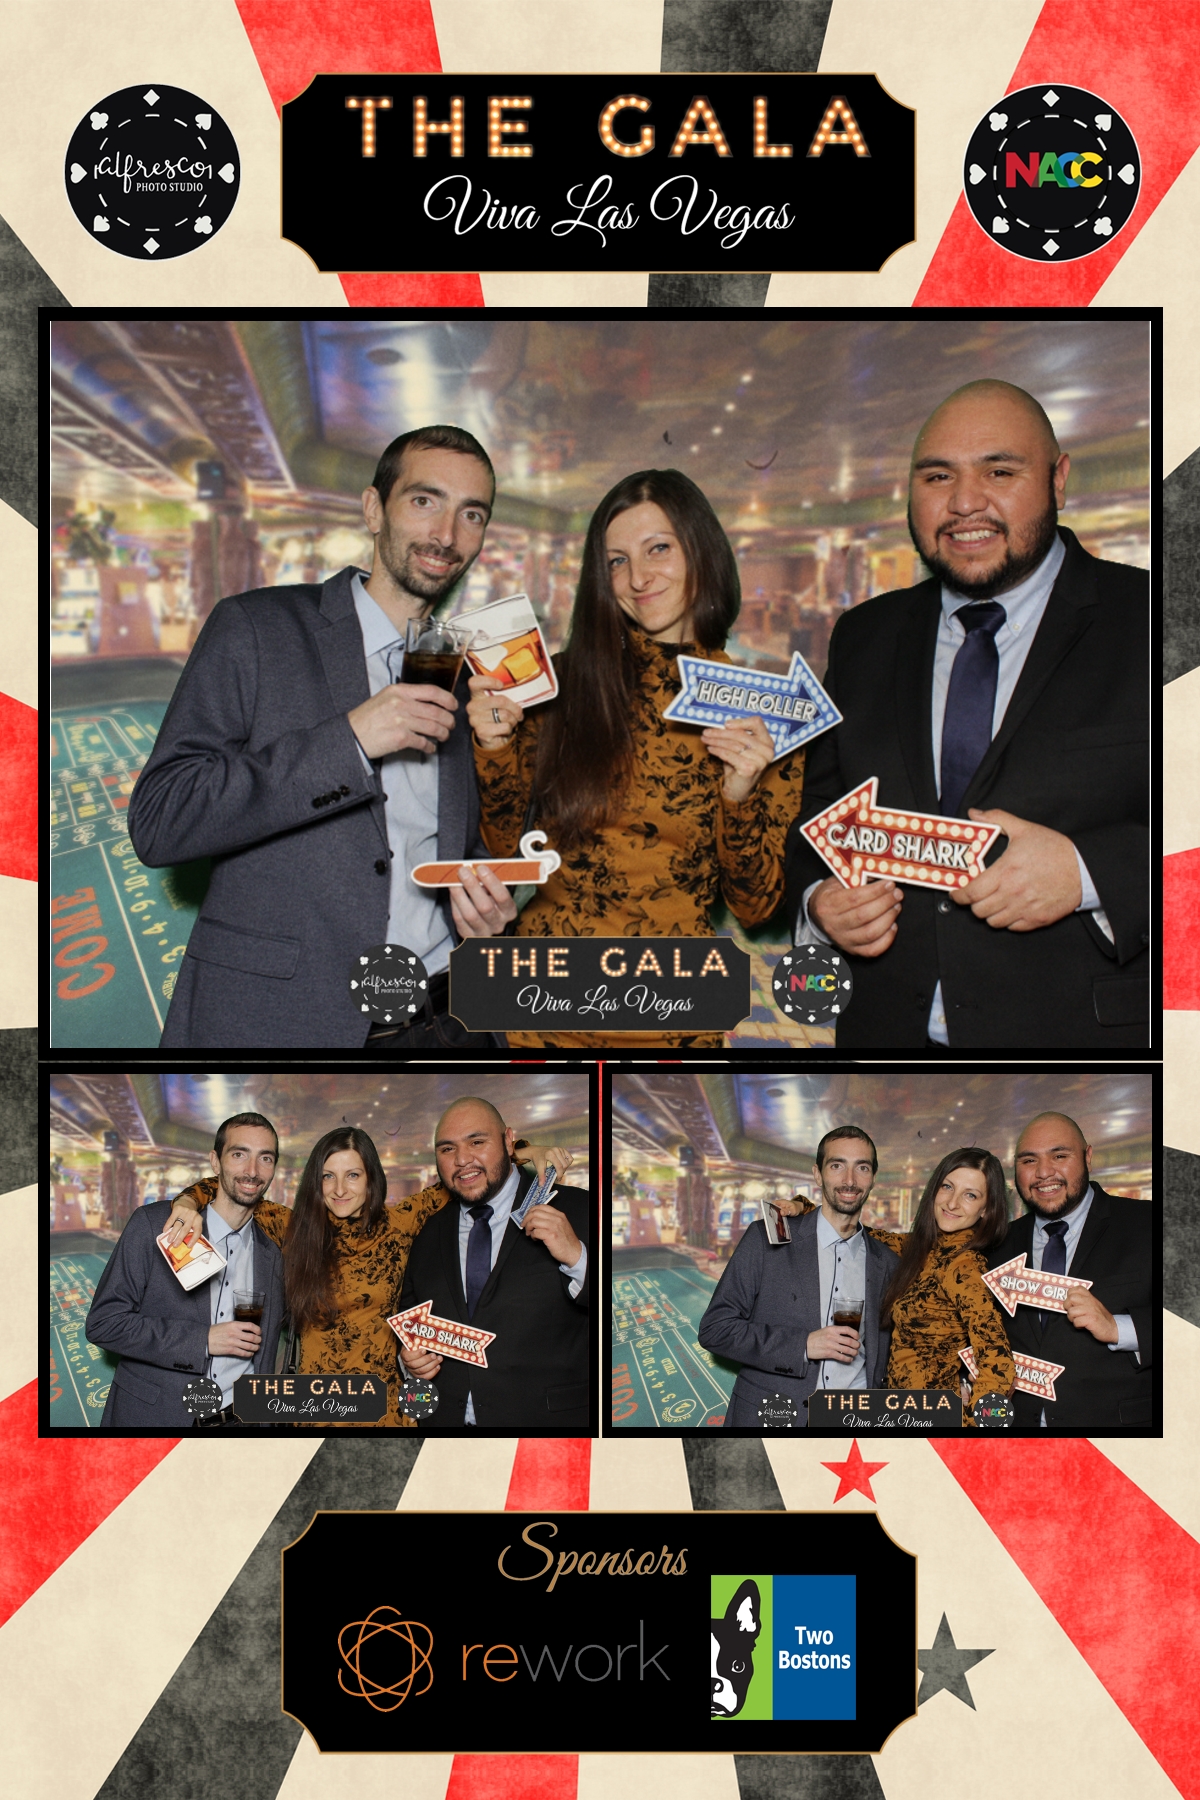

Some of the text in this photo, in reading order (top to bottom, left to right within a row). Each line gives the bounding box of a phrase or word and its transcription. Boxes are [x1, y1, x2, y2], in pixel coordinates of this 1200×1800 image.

[698, 680, 819, 723] HIGH ROLLER
[826, 822, 971, 870] CARD SHARK
[999, 1275, 1040, 1295] SHOW
[401, 1320, 480, 1354] CARD SHARK
[1014, 1363, 1049, 1386] HARK
